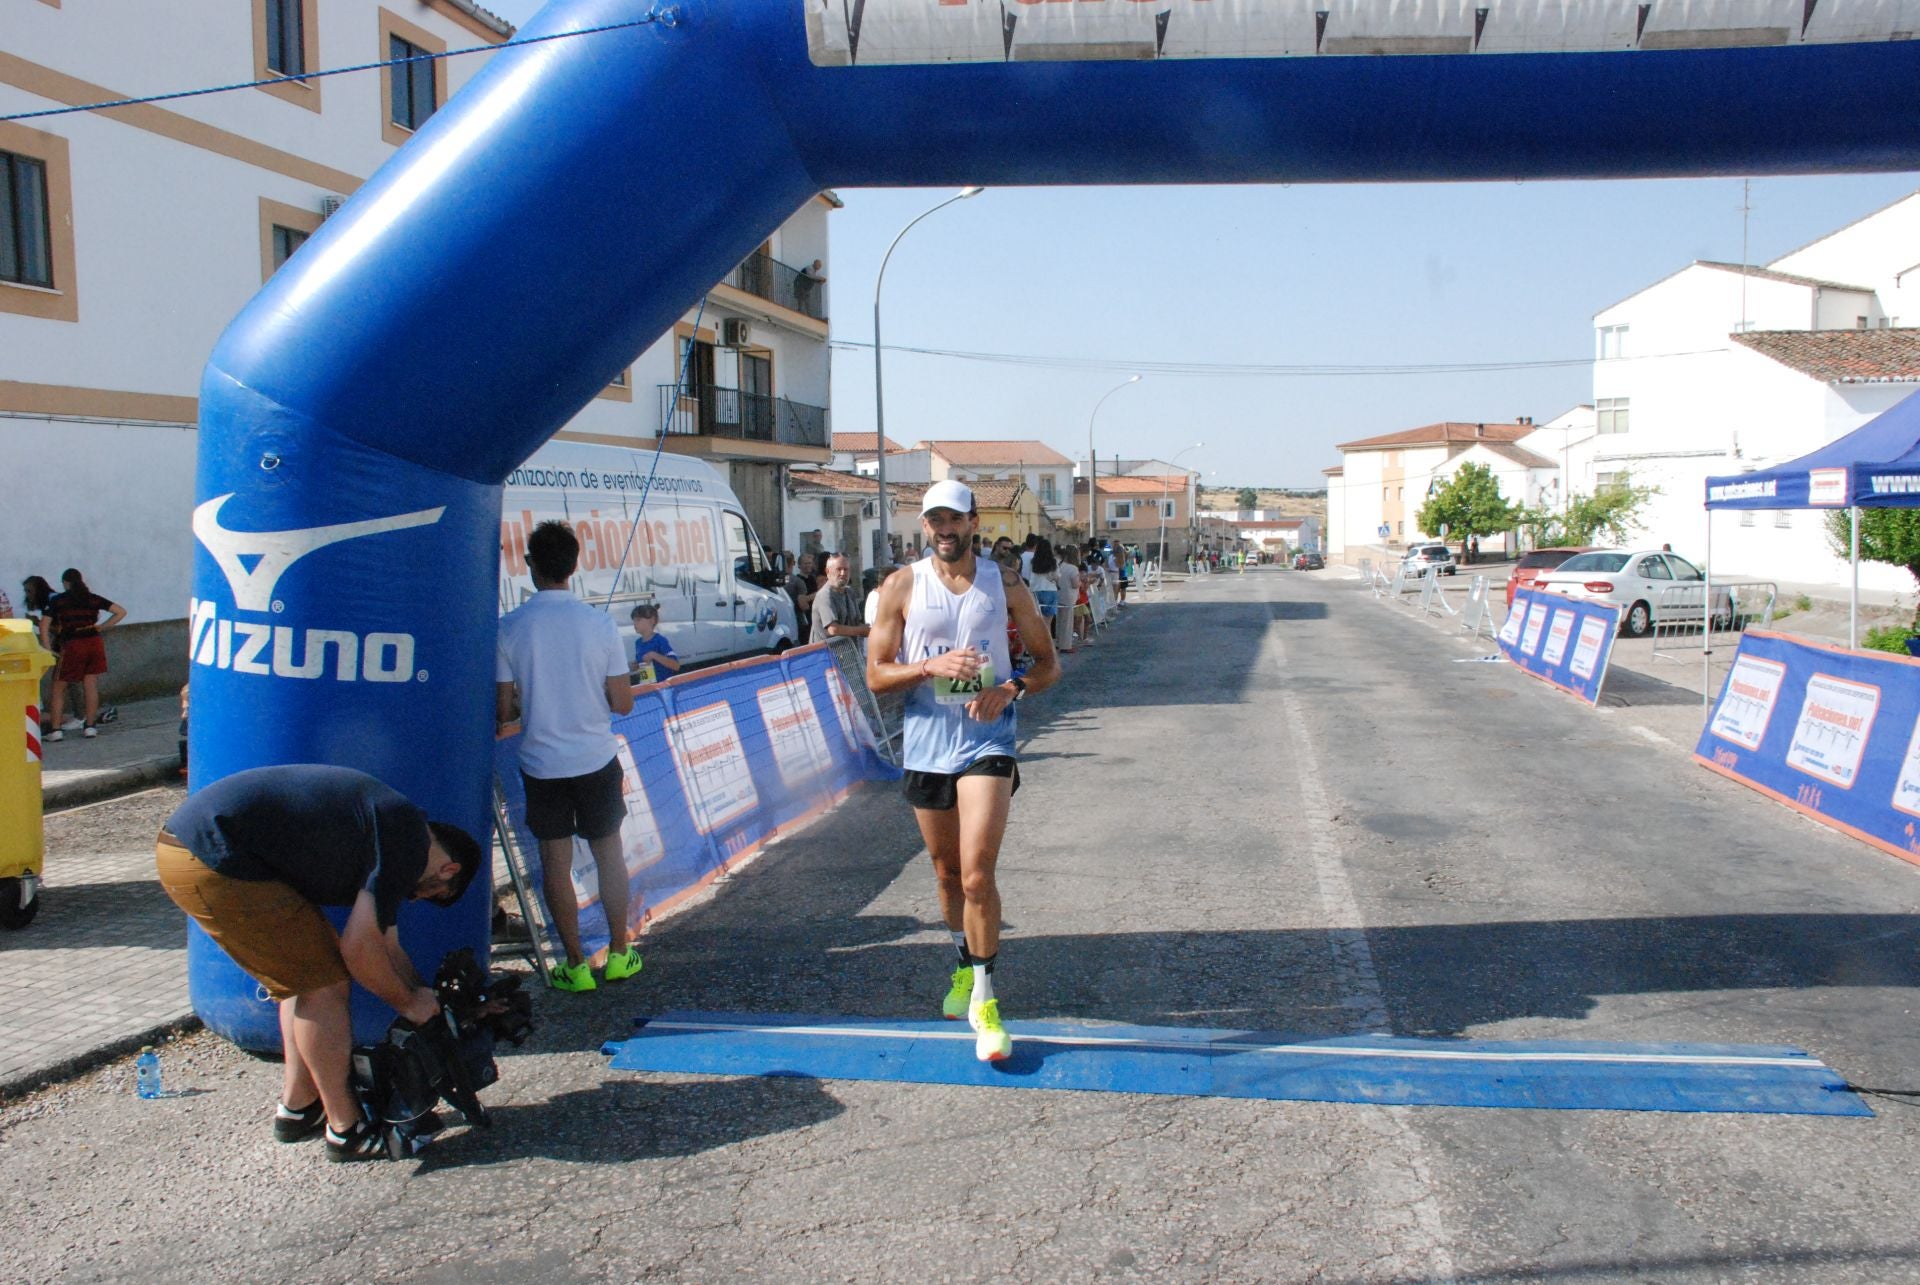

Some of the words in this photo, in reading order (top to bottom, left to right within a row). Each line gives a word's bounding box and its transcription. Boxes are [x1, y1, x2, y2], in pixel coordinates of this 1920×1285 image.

[581, 467, 598, 488] de
[603, 470, 648, 490] eventos
[650, 472, 704, 494] deportivos
[950, 673, 983, 693] 223
